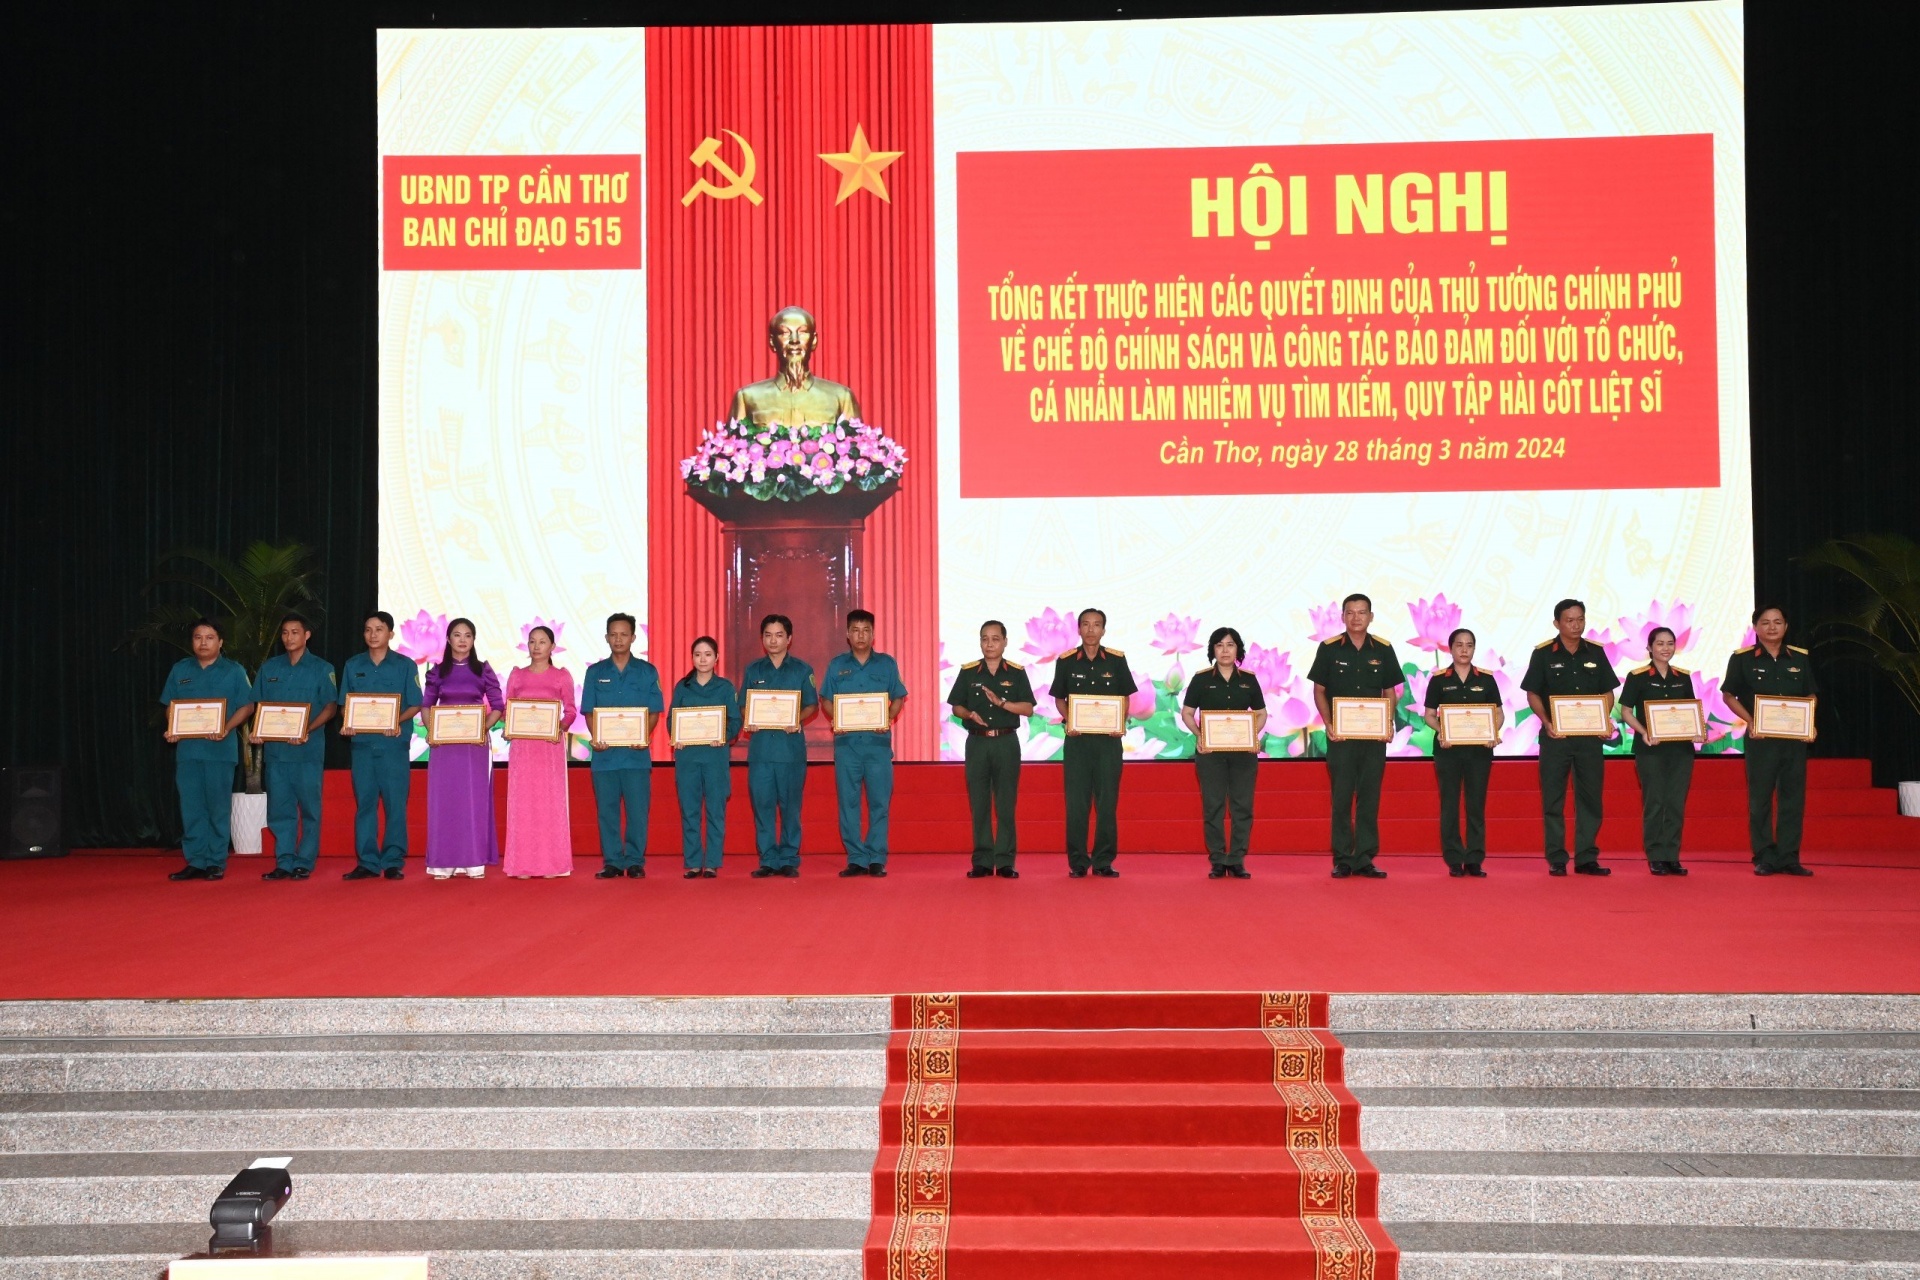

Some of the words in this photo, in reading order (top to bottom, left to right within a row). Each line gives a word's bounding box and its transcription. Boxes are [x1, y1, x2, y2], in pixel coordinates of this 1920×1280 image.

[400, 174, 471, 205] UBND
[478, 174, 510, 205] TP
[518, 164, 572, 205] CẦN
[579, 171, 630, 204] THƠ
[1190, 162, 1308, 251] HỘI
[1335, 170, 1508, 246] NGHỊ
[403, 217, 457, 247] BAN
[464, 205, 508, 247] CHỈ
[514, 216, 567, 253] ĐẠO
[575, 216, 622, 247] 515
[987, 270, 1044, 321] TỔNG
[1049, 271, 1089, 320] KẾT
[1093, 279, 1148, 327] THỰC
[1154, 274, 1204, 327] HIỆN
[1210, 273, 1254, 318] CÁC
[1259, 266, 1326, 321] QUYẾT
[1331, 278, 1383, 323] ĐỊNH
[1390, 261, 1434, 315] CỦA
[1438, 260, 1480, 313] THỦ
[1485, 264, 1558, 313] TƯỚNG
[1564, 265, 1631, 311] CHÍNH
[1637, 255, 1682, 309] PHỦ
[1000, 323, 1027, 372] VỀ
[1032, 322, 1075, 372] CHẾ
[1079, 327, 1109, 379] ĐỘ
[1114, 326, 1180, 371] CHÍNH
[1187, 325, 1244, 370] SÁCH
[1249, 324, 1278, 369] VÀ
[1283, 323, 1342, 368] CÔNG
[1348, 322, 1389, 367] TÁC
[1395, 313, 1439, 366] BẢO
[1444, 312, 1494, 365] ĐẢM
[1499, 314, 1537, 364] ĐỐI
[1542, 315, 1578, 363] VỚI
[1583, 310, 1611, 363] TỔ
[1617, 313, 1683, 365] CHỨC,
[1029, 379, 1059, 423] CÁ
[1064, 378, 1125, 422] NHÂN
[1130, 377, 1176, 422] LÀM
[1182, 376, 1252, 428] NHIỆM
[1257, 383, 1286, 428] VỤ
[1291, 375, 1331, 419] TÌM
[1337, 368, 1398, 422] KIẾM,
[1404, 380, 1446, 421] QUY
[1451, 372, 1493, 424] TẬP
[1499, 371, 1536, 415] HÀI
[1542, 365, 1583, 415] CỐT
[1589, 369, 1633, 422] LIỆT
[1640, 369, 1663, 413] SĨ
[1159, 435, 1204, 465] Cần
[1213, 440, 1263, 467] Thơ,
[1270, 438, 1329, 469] ngày
[1333, 440, 1359, 462] 28
[1366, 436, 1433, 467] tháng
[1438, 438, 1451, 460] 3
[1458, 436, 1509, 460] năm
[1515, 437, 1566, 459] 2024
